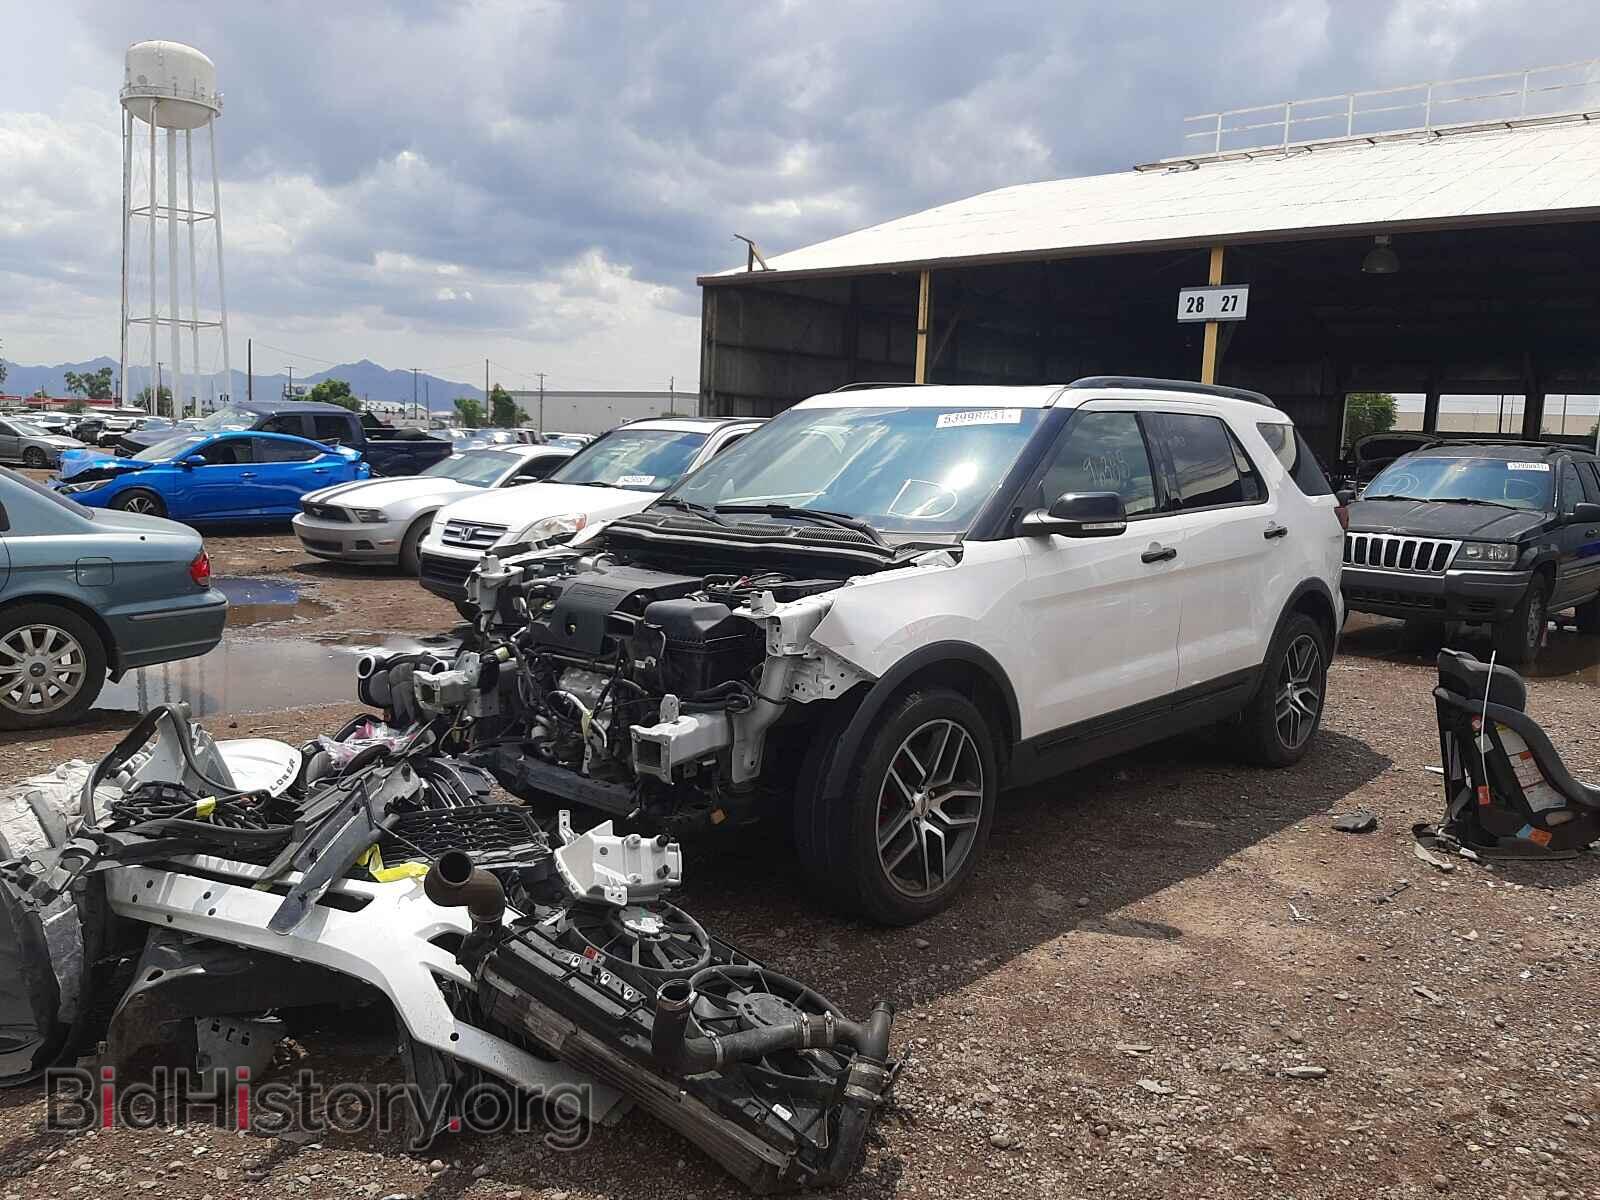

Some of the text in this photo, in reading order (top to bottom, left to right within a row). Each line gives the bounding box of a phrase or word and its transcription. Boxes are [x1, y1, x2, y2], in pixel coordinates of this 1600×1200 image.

[1186, 295, 1239, 313] 28 27
[270, 758, 295, 791] LORER
